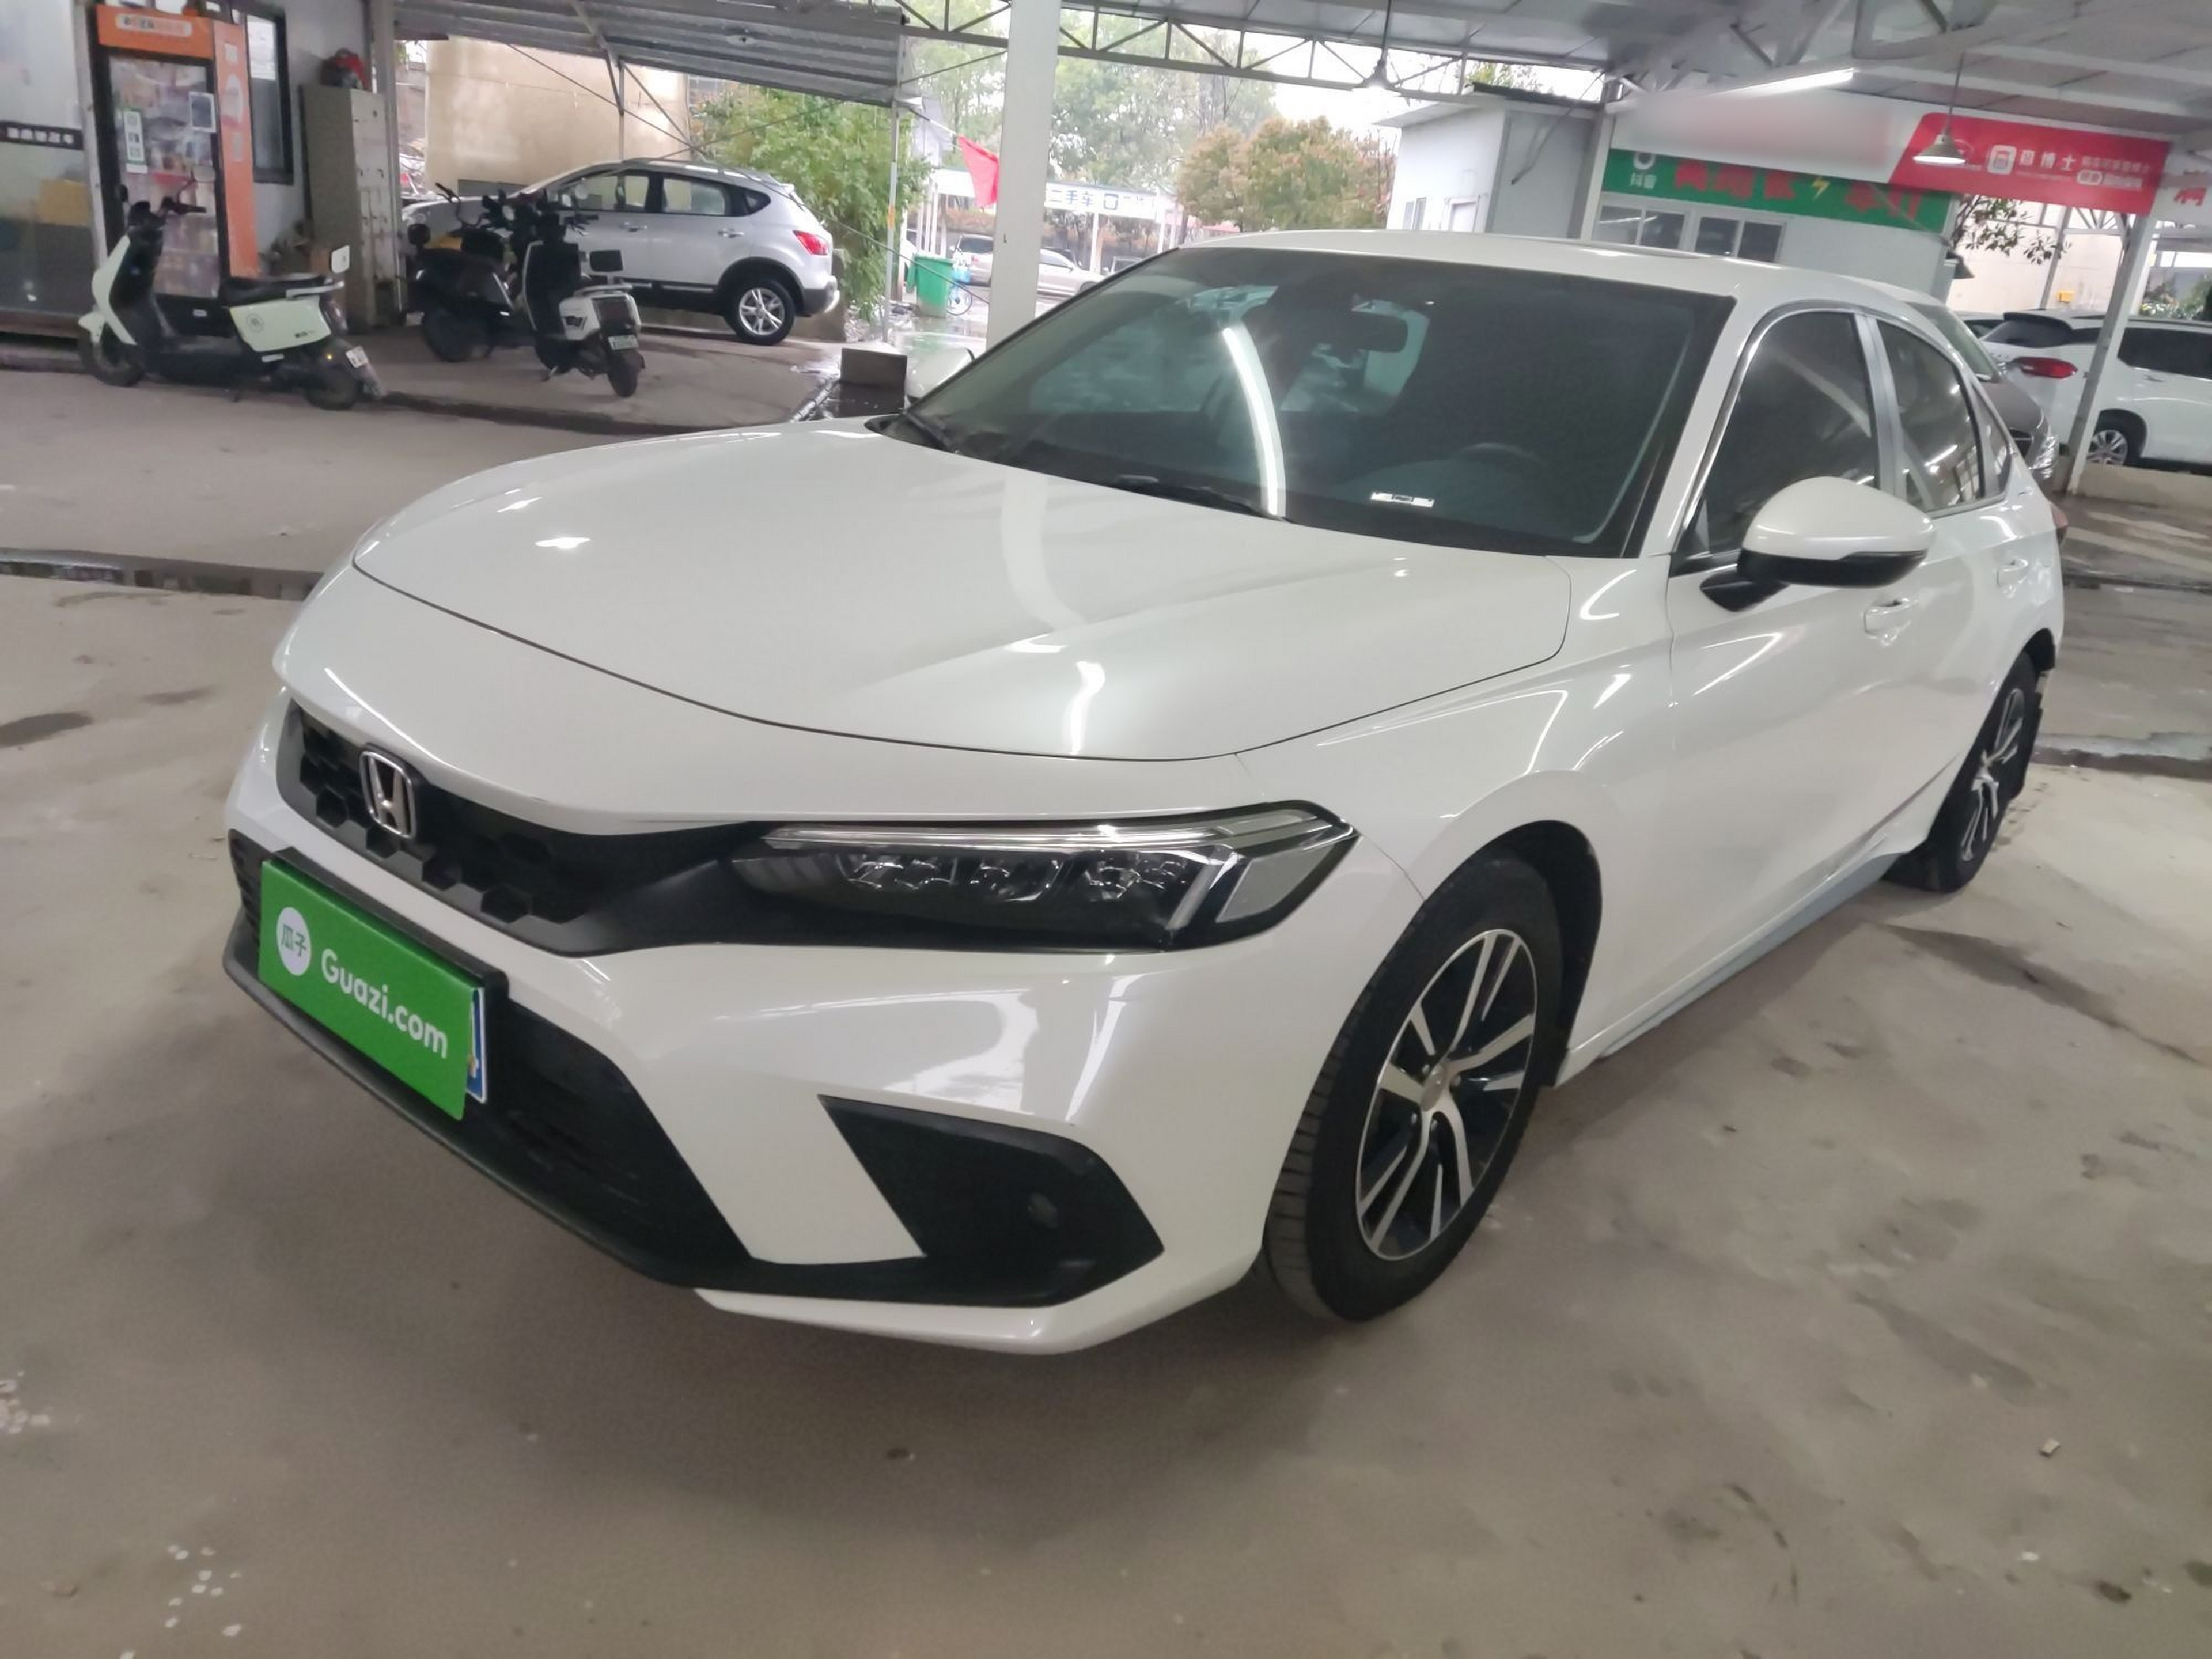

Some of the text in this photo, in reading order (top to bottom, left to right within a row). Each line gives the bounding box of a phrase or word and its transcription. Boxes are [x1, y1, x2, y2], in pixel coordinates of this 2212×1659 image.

[1049, 189, 1094, 206] 二手车
[281, 923, 307, 957] 瓜子
[321, 949, 448, 1059] Guazi.com
